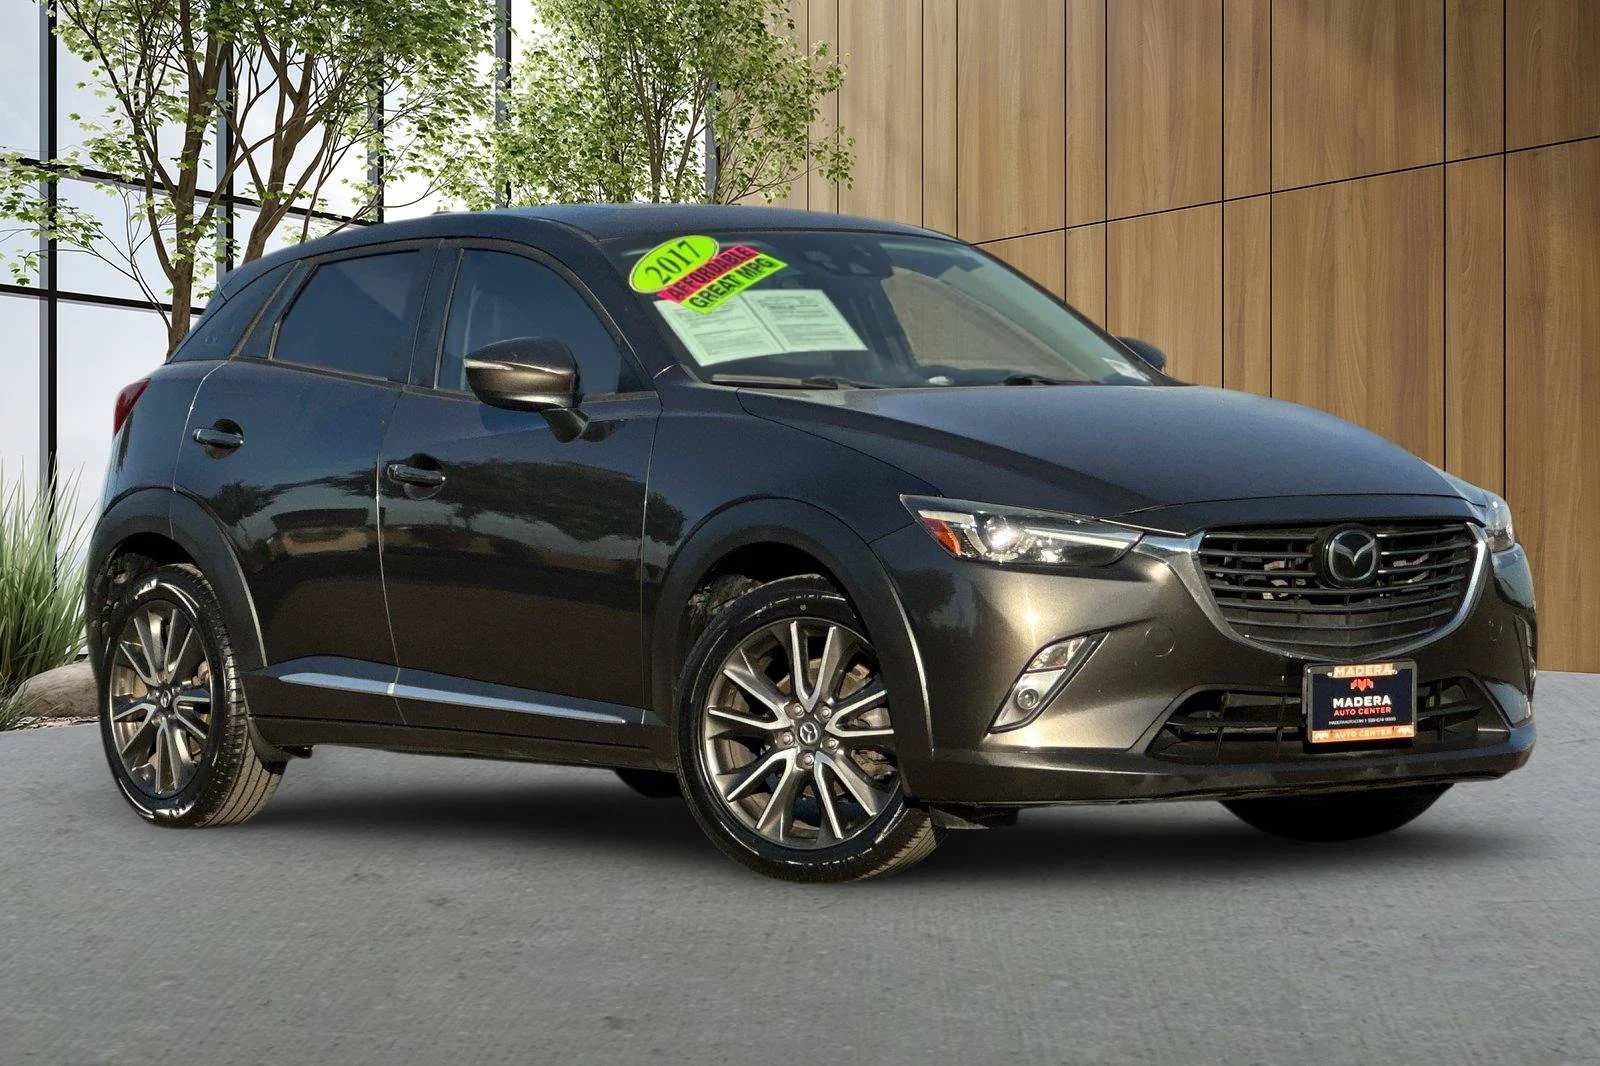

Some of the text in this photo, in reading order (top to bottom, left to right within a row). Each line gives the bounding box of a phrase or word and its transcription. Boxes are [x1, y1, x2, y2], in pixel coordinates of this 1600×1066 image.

[645, 241, 701, 284] 2017
[667, 246, 750, 299] AFFORDABLE
[689, 257, 774, 309] GREAT MPG
[1334, 664, 1392, 677] MADERA
[1333, 695, 1392, 708] MADERA
[1334, 706, 1392, 717] AUTO CENTER
[1335, 727, 1392, 738] AUTO CENTER
